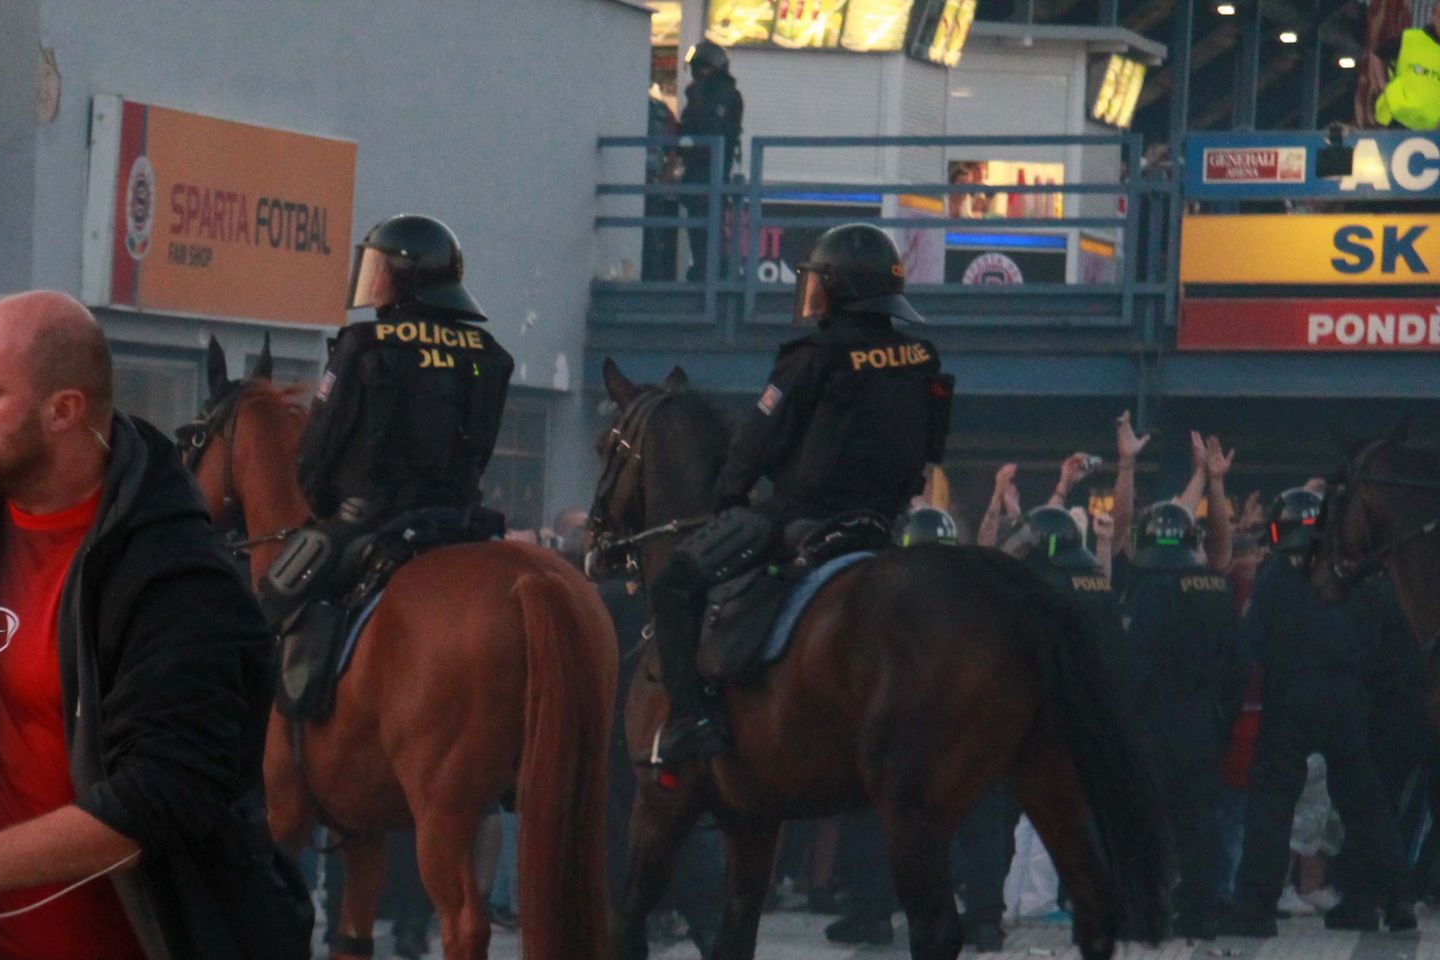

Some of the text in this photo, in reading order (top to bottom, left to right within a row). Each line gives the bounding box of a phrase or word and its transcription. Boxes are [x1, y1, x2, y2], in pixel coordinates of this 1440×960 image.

[169, 183, 252, 246] SPARTA
[254, 196, 332, 256] FOTBAL
[1330, 223, 1430, 276] SK
[375, 321, 484, 350] POLICIE
